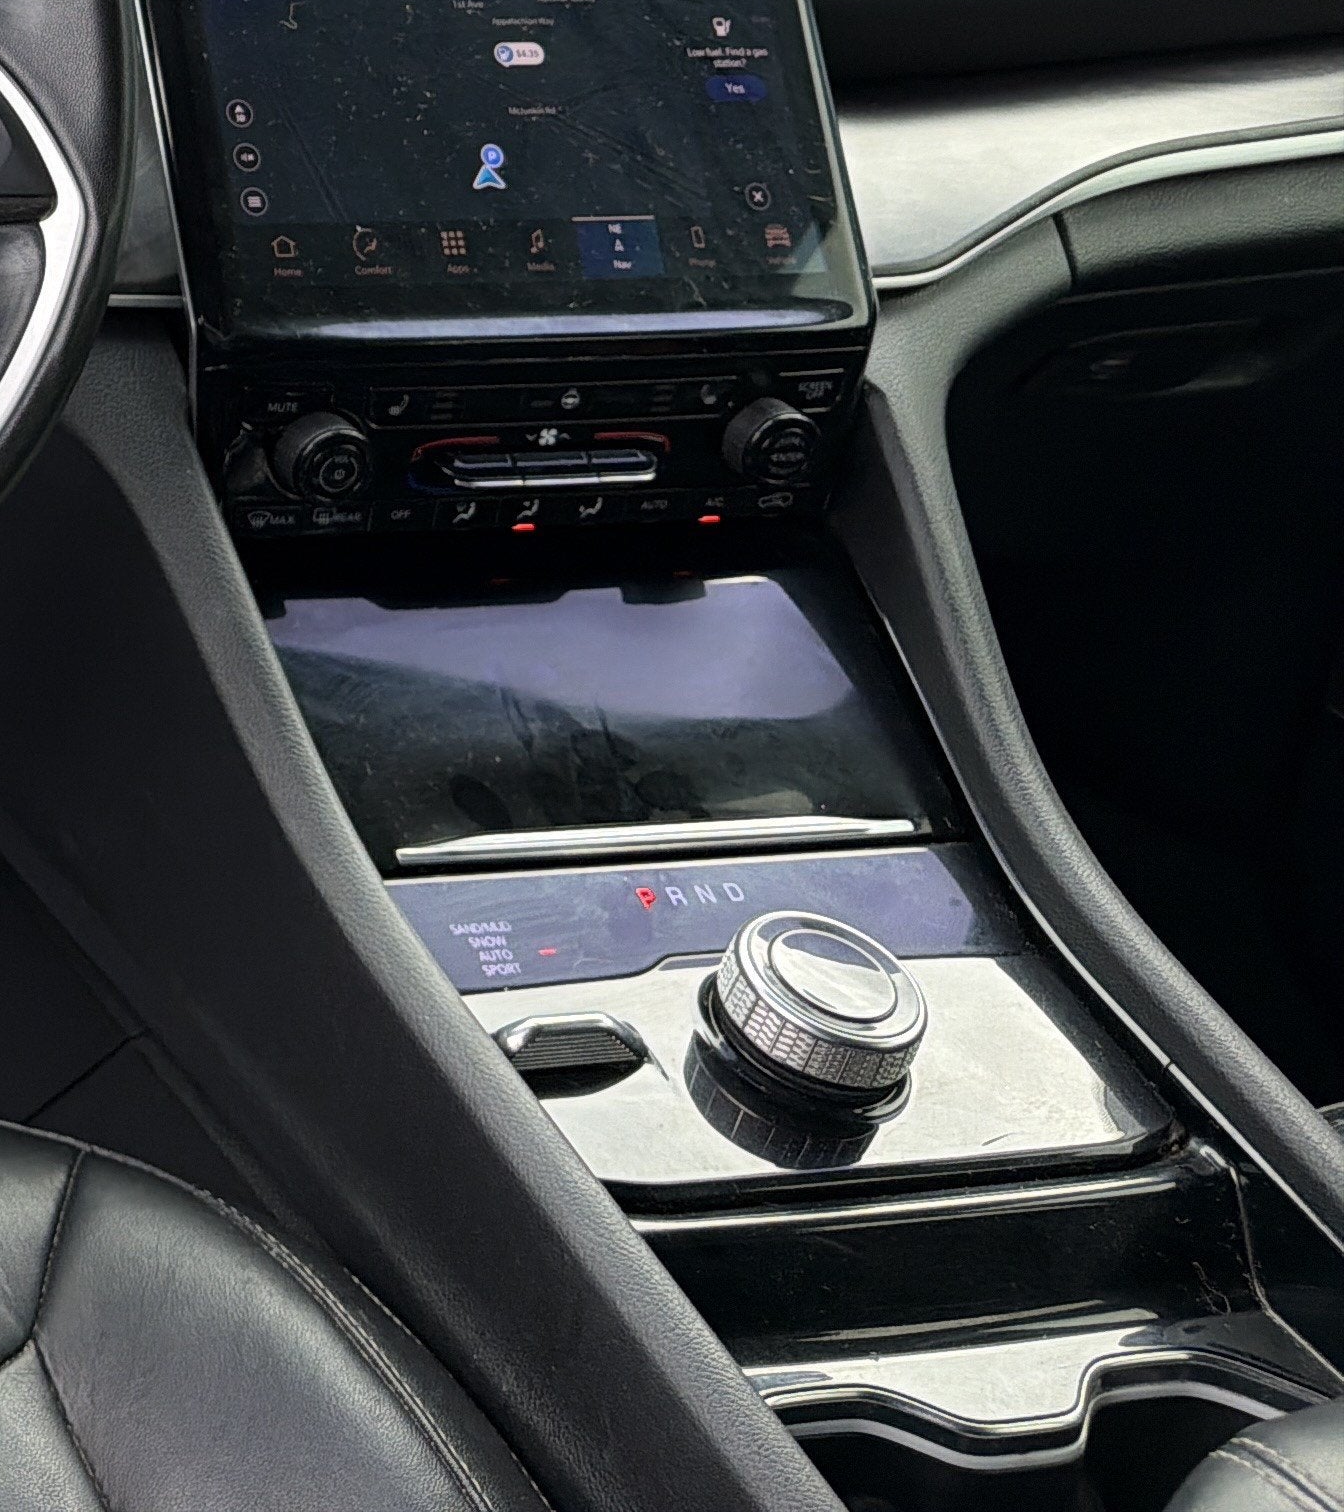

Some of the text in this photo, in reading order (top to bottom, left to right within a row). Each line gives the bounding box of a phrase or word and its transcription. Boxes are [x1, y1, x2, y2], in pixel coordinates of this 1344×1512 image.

[724, 82, 746, 94] Yes
[273, 267, 304, 277] Home
[354, 265, 392, 276] Comfort
[446, 264, 470, 275] Apps
[267, 401, 299, 414] MUTE
[269, 514, 296, 526] MAX
[390, 509, 412, 521] OFF
[664, 885, 689, 906] R
[693, 883, 718, 904] N
[722, 882, 746, 902] D
[467, 934, 508, 949] SNOW
[478, 947, 514, 962] AUTO
[481, 962, 523, 977] SPORT
